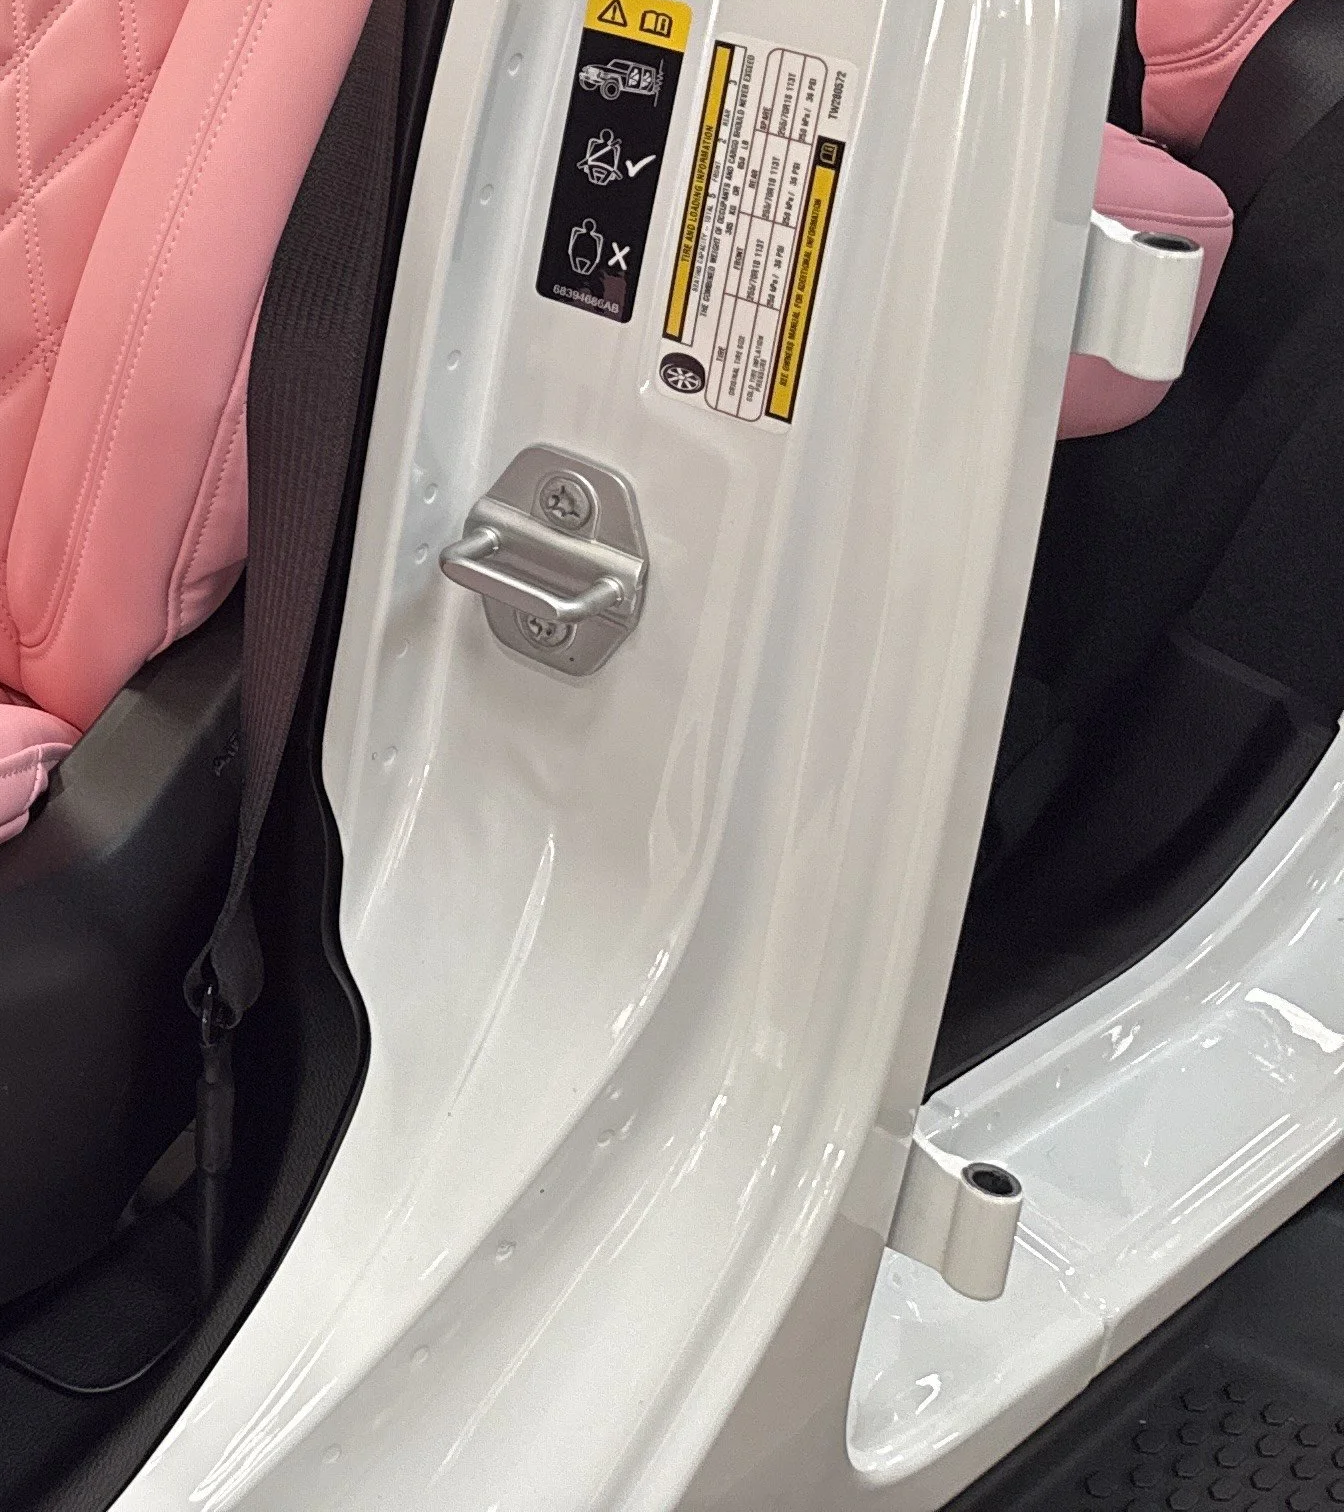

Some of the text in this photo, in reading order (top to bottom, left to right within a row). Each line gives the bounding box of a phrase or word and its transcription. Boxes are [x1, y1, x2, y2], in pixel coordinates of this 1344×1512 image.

[828, 70, 845, 119] TW280572
[760, 106, 769, 130] SPARE
[749, 168, 757, 188] REAR
[682, 124, 712, 262] TIRE AND LOADING INFORMATION
[733, 246, 743, 270] FRONT
